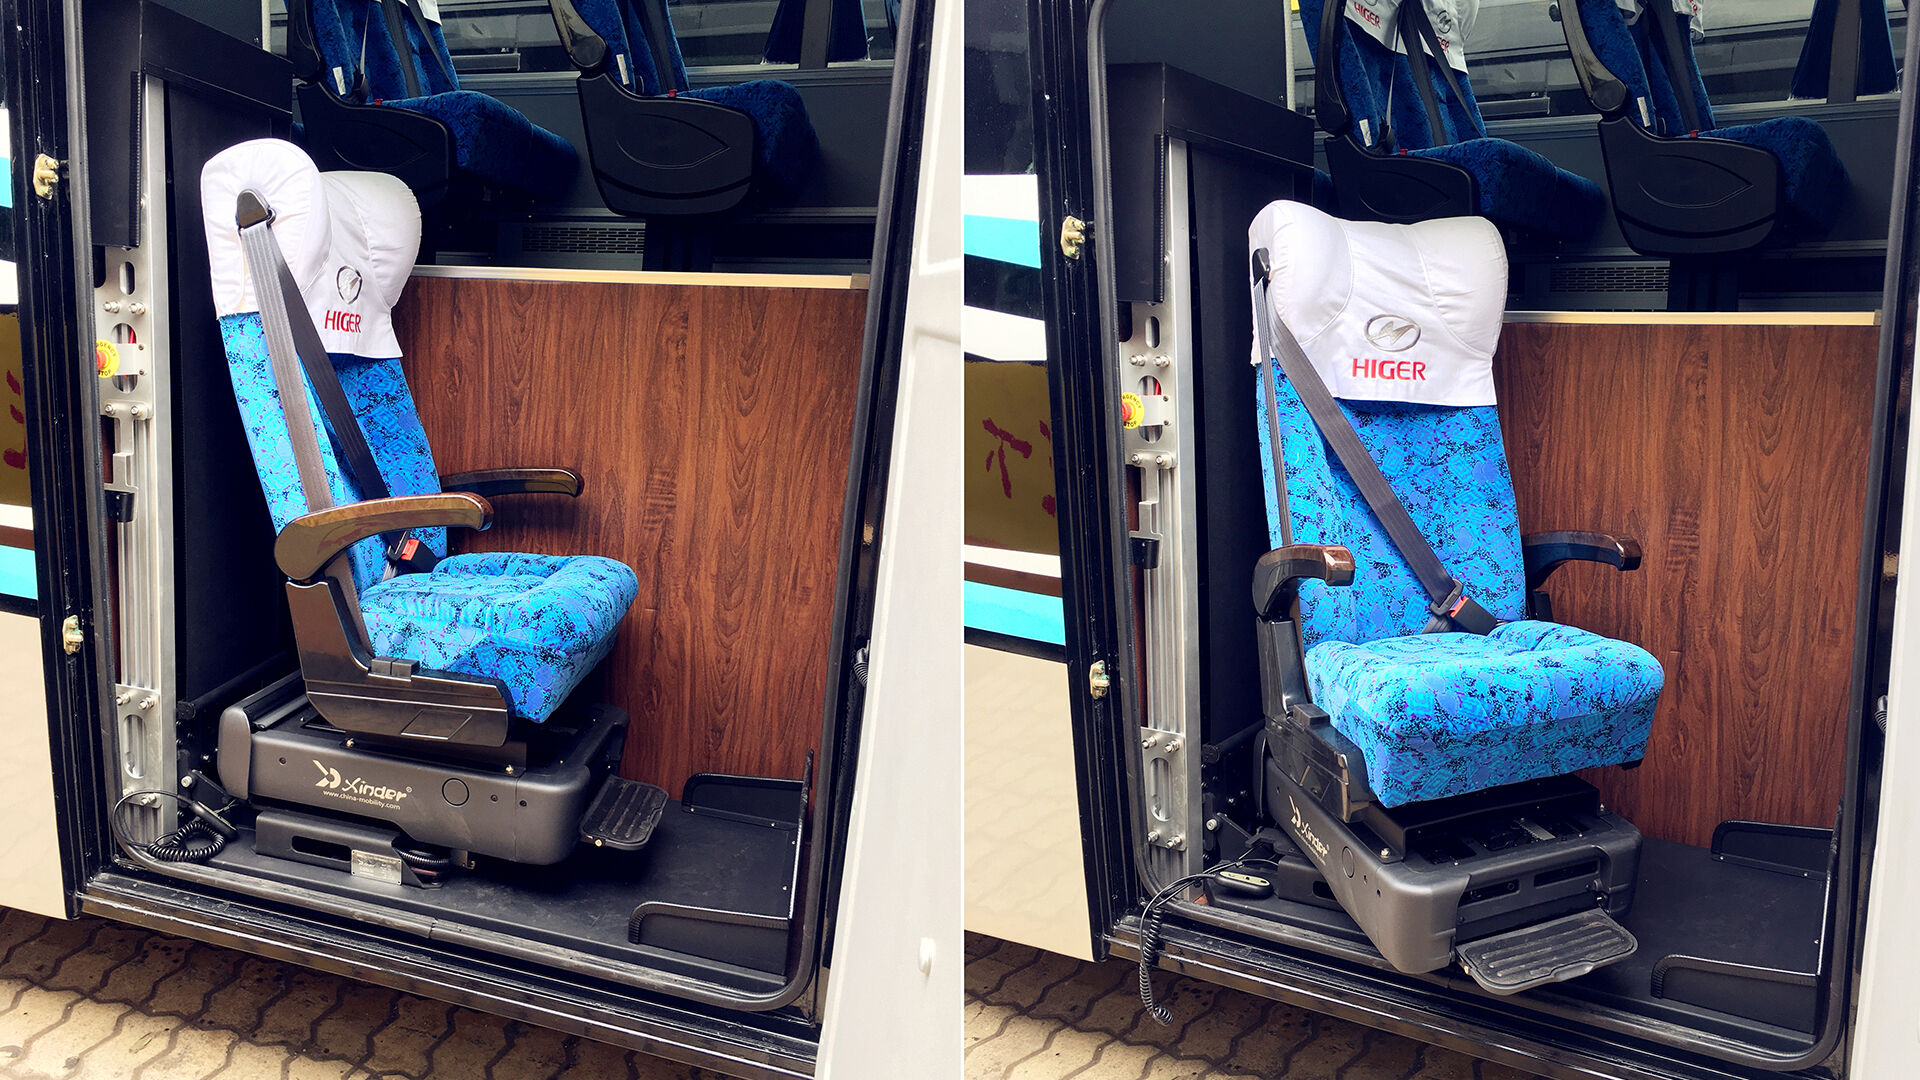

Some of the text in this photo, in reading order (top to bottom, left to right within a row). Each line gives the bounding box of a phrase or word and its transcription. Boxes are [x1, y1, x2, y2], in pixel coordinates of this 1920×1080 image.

[1353, 1, 1380, 29] HIGER
[324, 309, 362, 333] HIGER
[1352, 358, 1426, 381] HIGER
[322, 790, 401, 811] www.china-mobility.com
